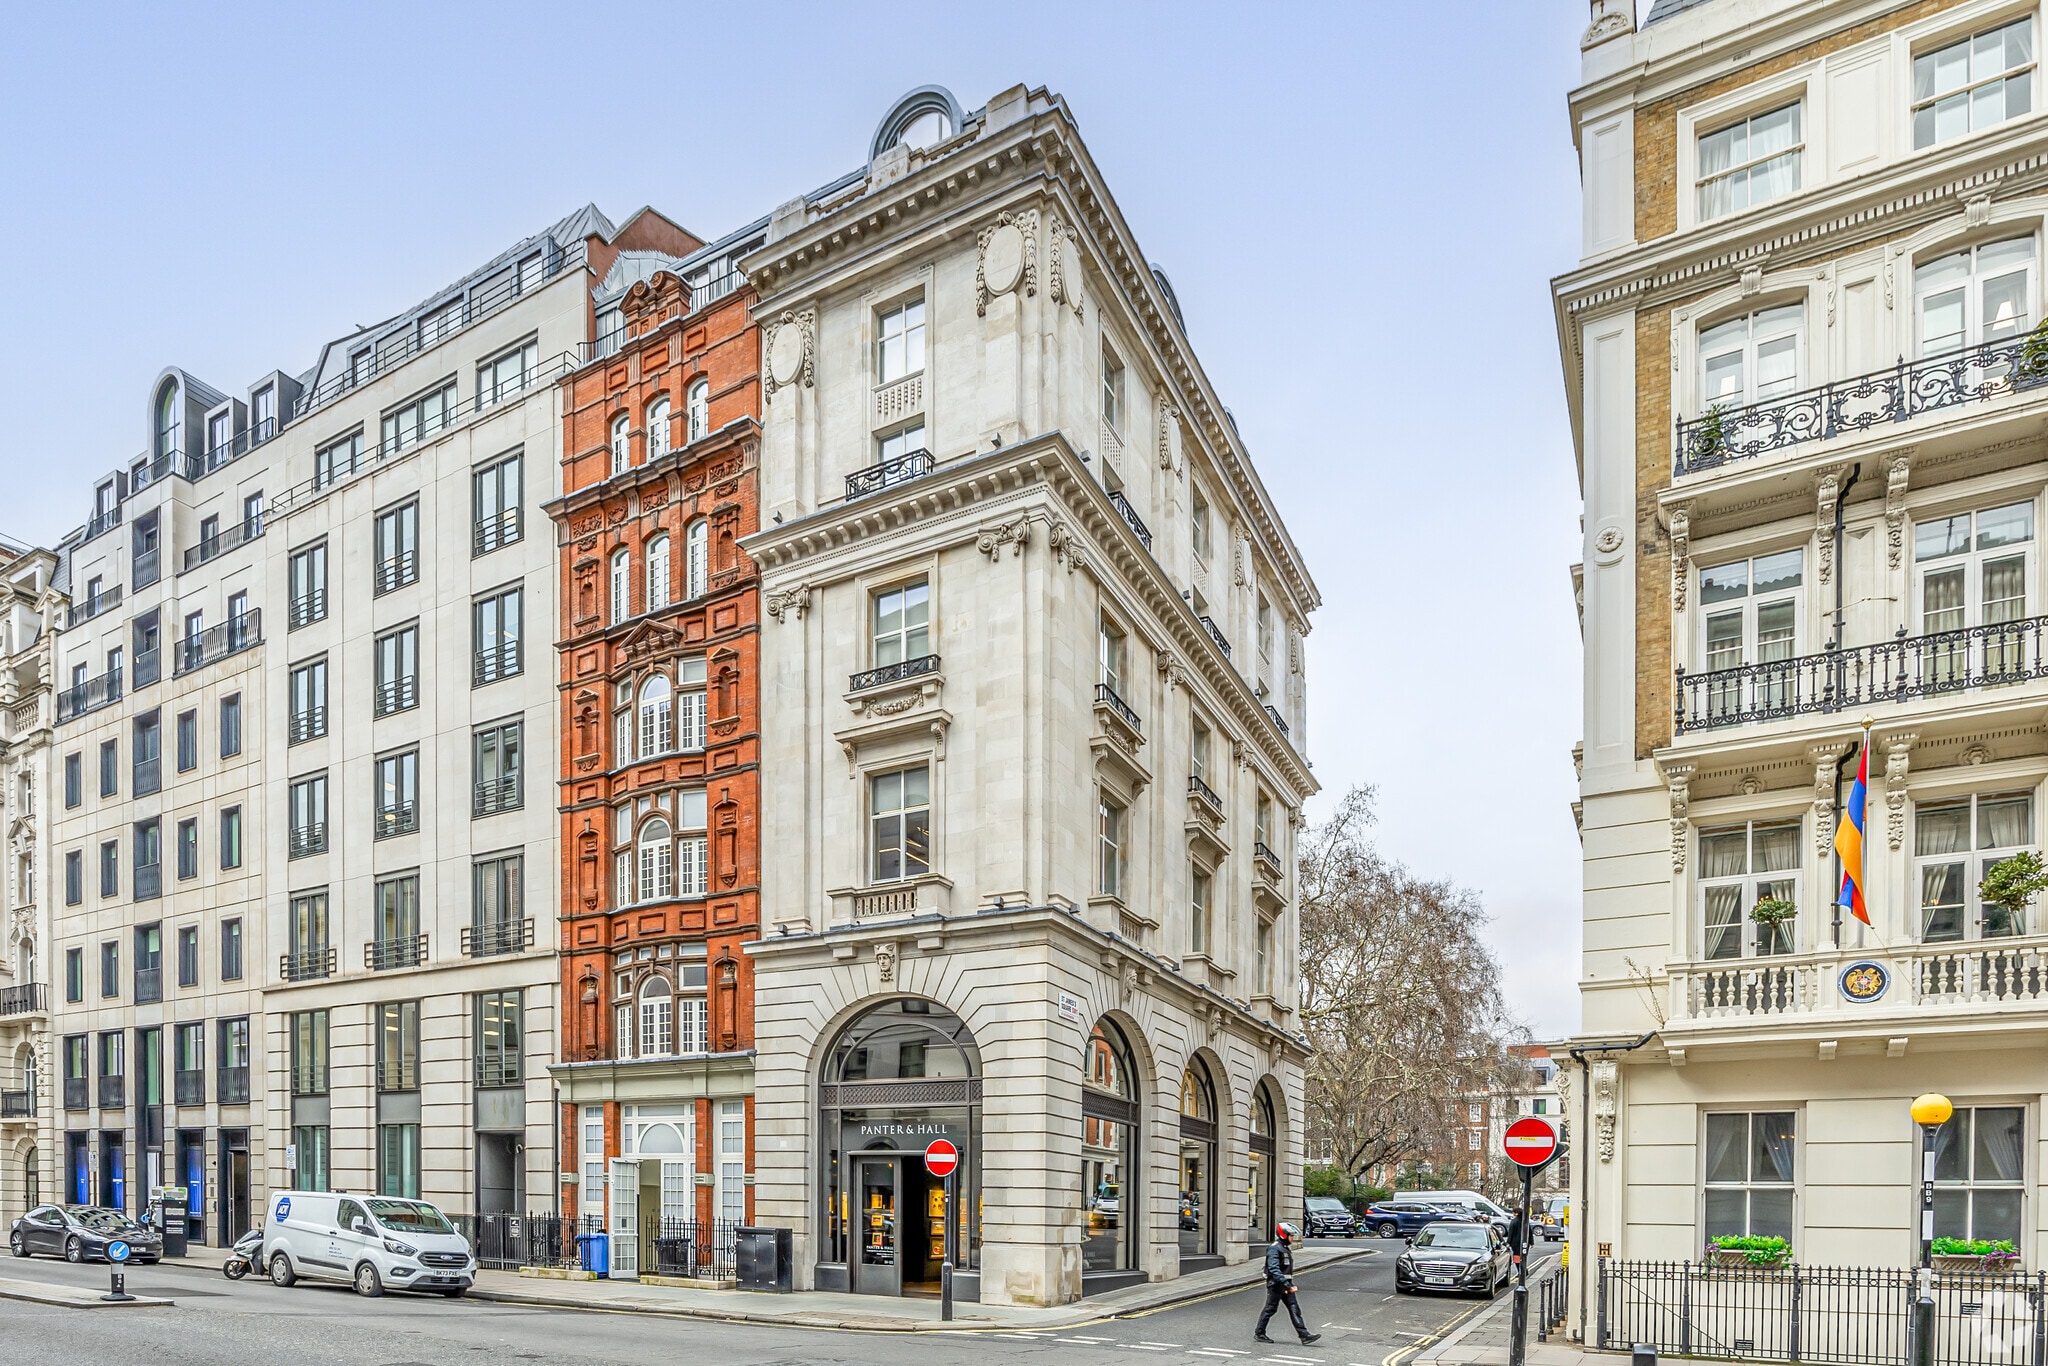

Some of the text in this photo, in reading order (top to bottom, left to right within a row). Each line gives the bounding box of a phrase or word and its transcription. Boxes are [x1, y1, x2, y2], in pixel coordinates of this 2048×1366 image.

[861, 1124, 947, 1135] PANTER & HALL
